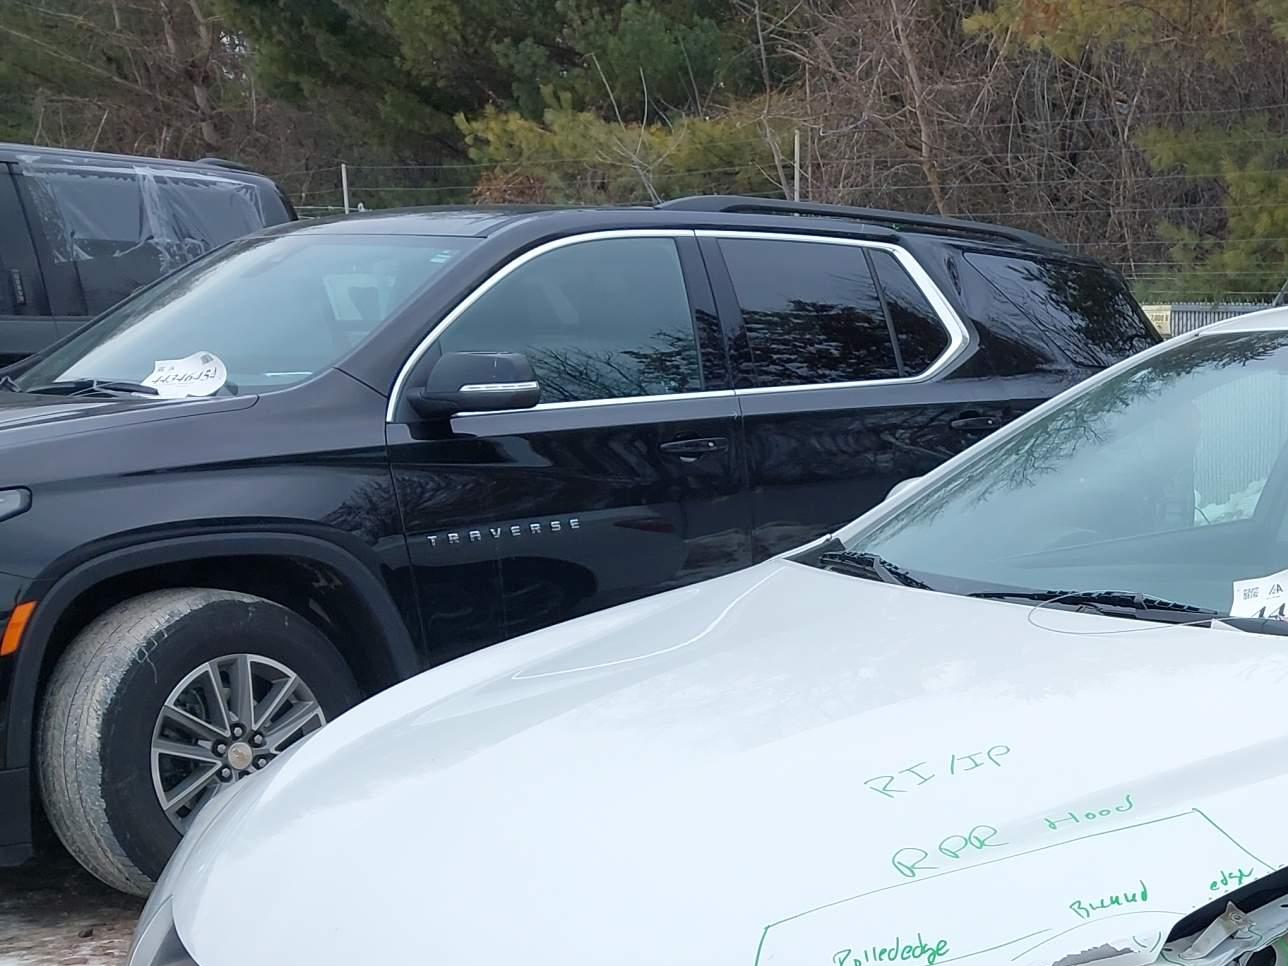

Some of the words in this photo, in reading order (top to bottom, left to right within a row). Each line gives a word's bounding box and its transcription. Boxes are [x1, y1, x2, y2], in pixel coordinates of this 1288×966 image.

[427, 518, 581, 547] TRAVERSE
[892, 825, 1008, 877] RPR
[1044, 795, 1133, 831] Hood
